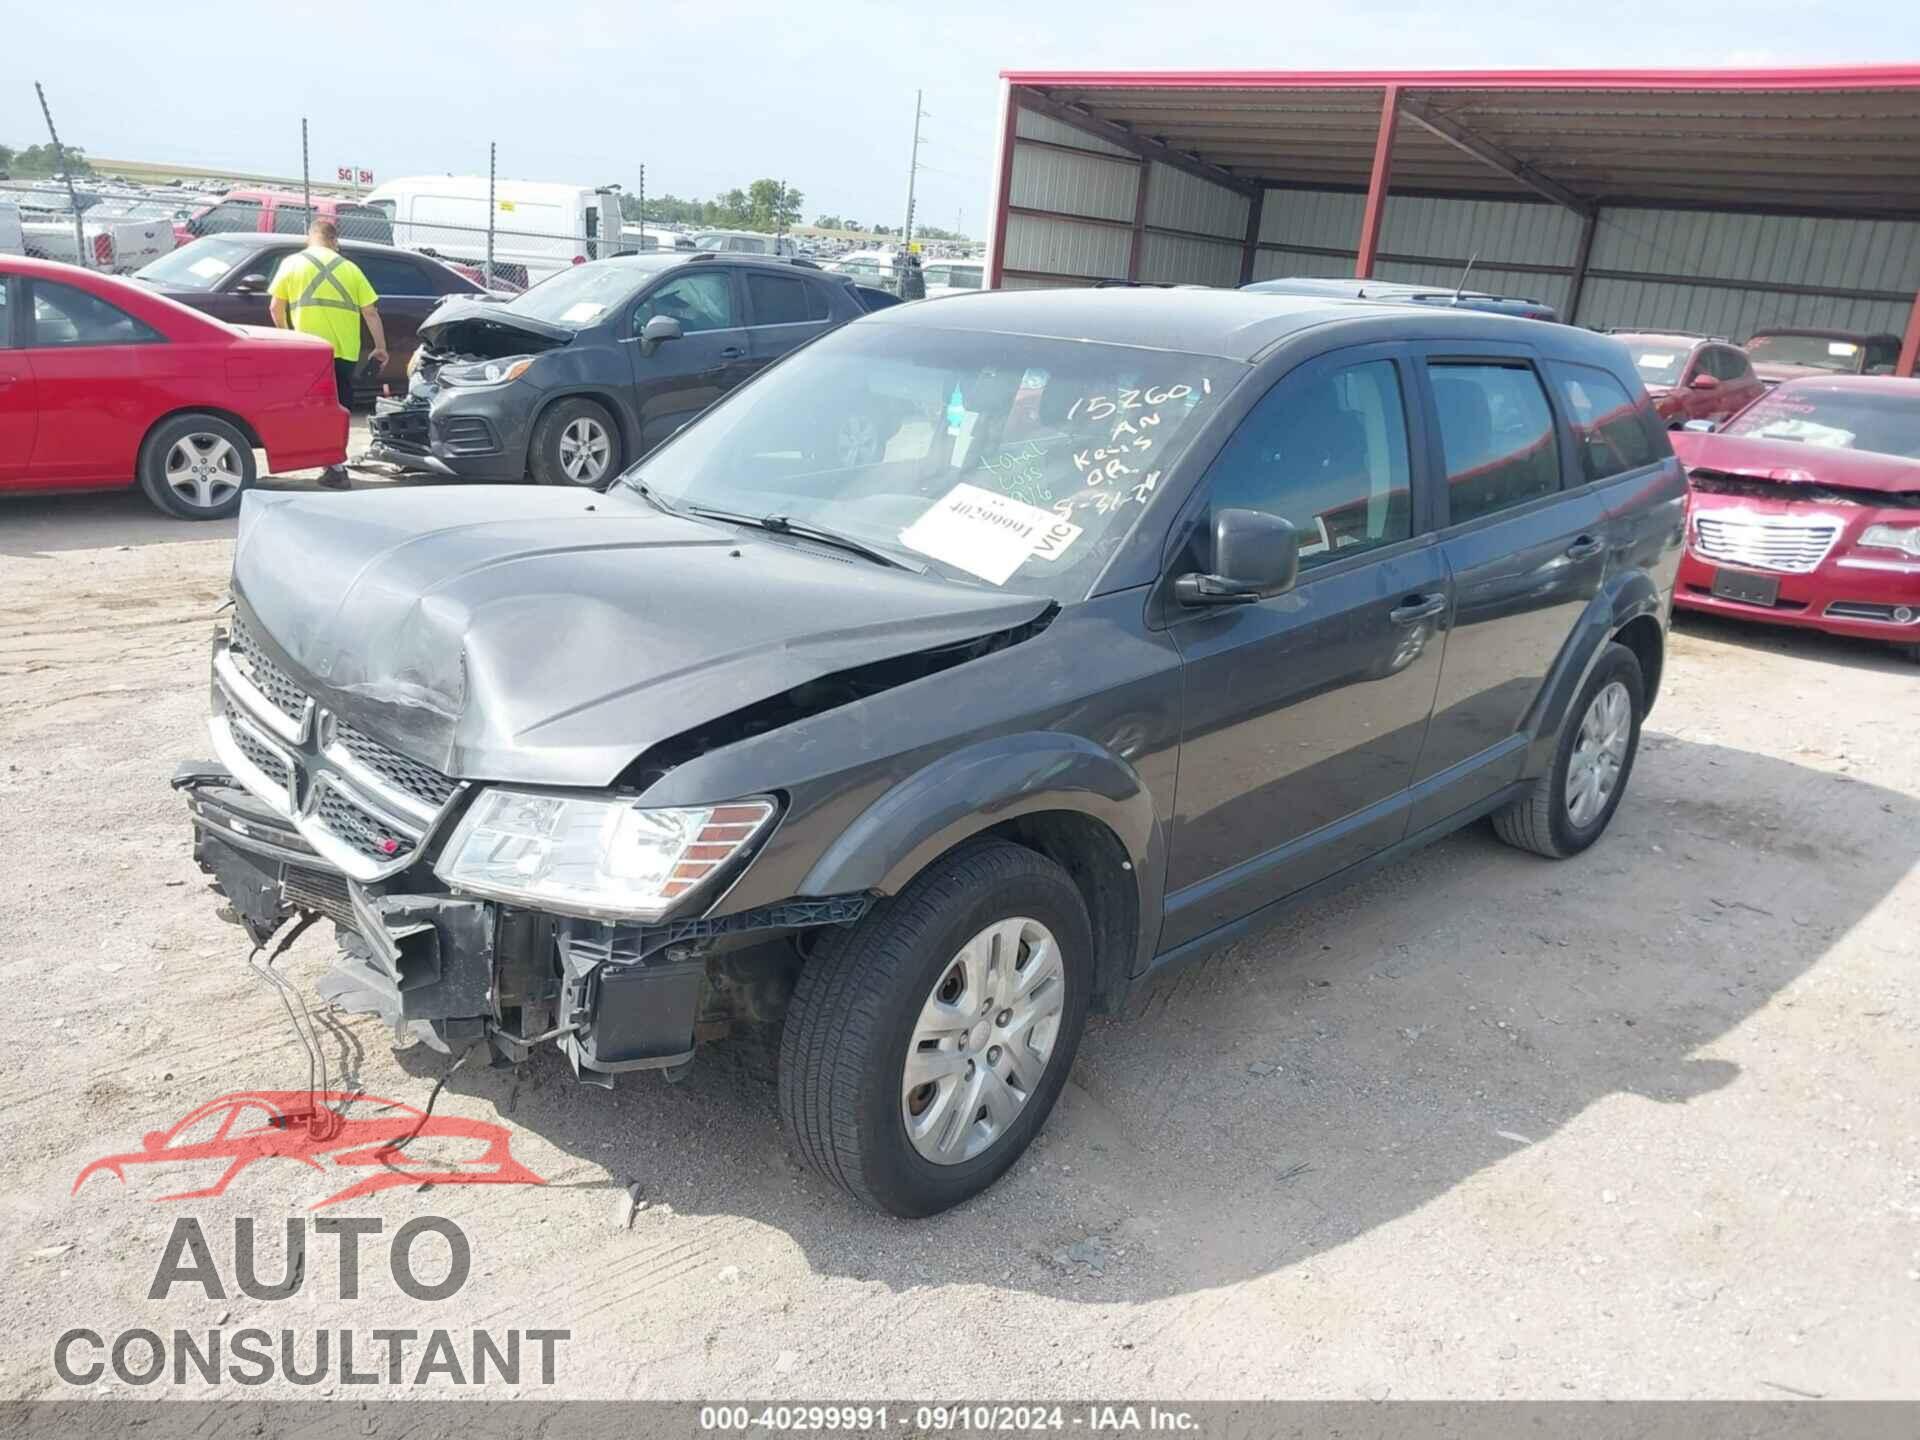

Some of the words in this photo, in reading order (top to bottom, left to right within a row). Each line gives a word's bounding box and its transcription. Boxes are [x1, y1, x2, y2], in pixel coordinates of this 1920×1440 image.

[337, 168, 353, 181] SG
[359, 170, 374, 184] SH
[1033, 523, 1072, 551] VIC
